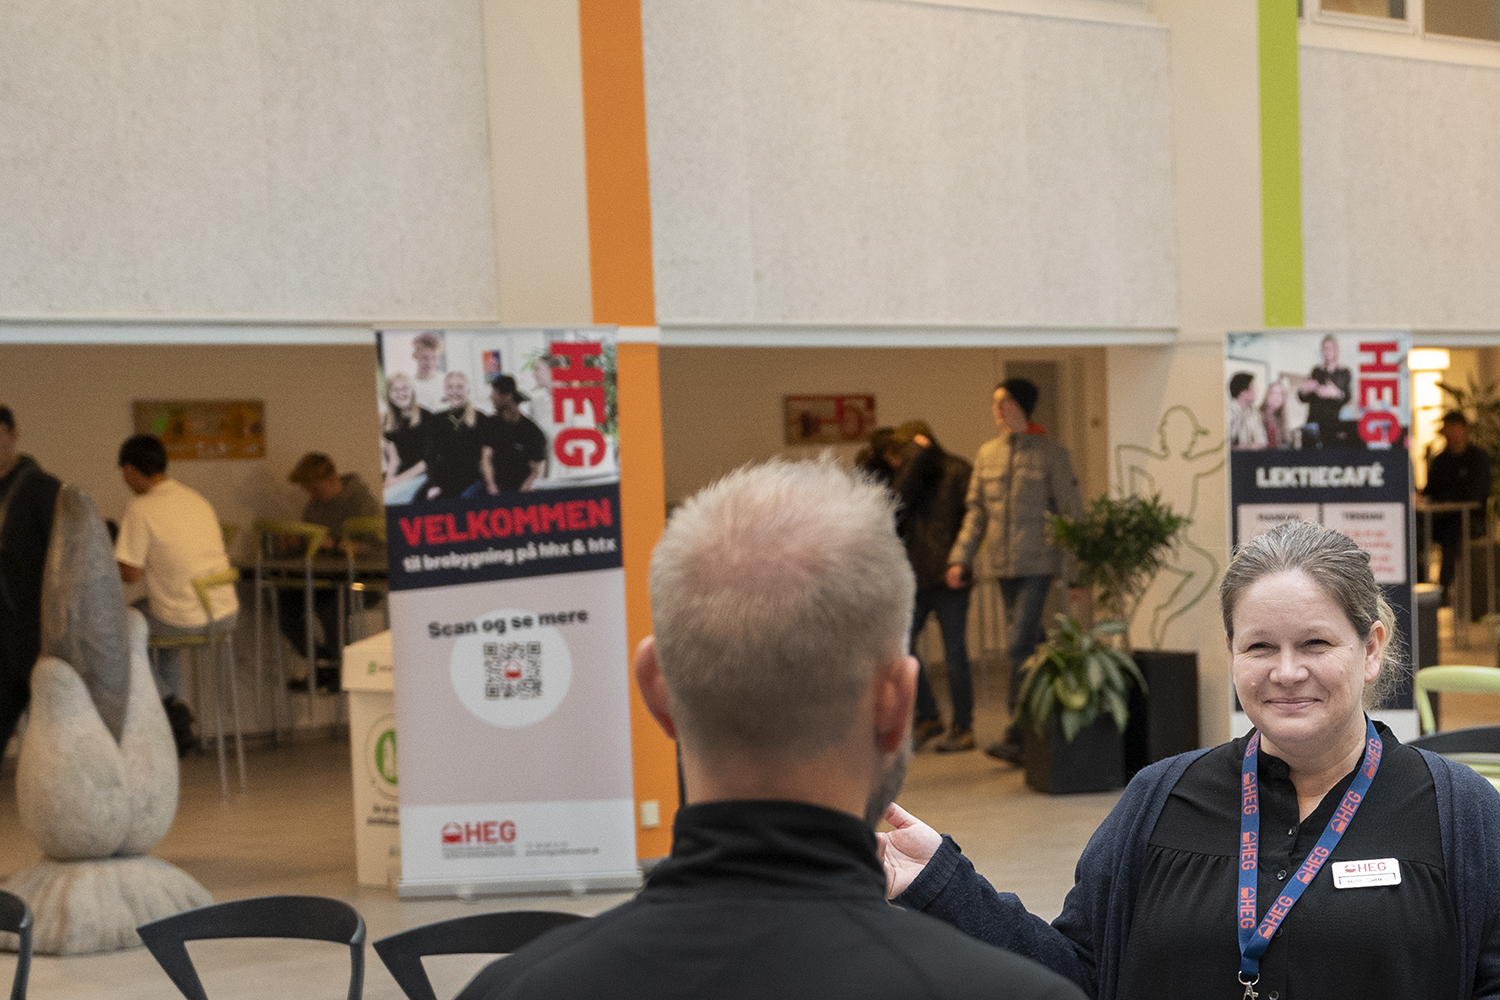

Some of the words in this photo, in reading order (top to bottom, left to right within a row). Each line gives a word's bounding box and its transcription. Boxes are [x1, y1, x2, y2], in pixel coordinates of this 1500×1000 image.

[550, 341, 607, 468] HEG
[1358, 343, 1401, 444] HEG
[1256, 462, 1385, 488] LEKTIECAFÉ
[399, 498, 613, 547] VELKOMMEN
[402, 554, 421, 572] til
[423, 547, 514, 570] brobygning
[516, 541, 537, 564] på
[572, 538, 585, 555] &
[428, 621, 477, 638] Scan
[482, 618, 506, 634] og
[511, 615, 533, 629] se
[538, 610, 588, 626] mere
[1366, 738, 1382, 766] HEG
[1243, 783, 1258, 815] HEG
[1336, 790, 1361, 825] HEG
[465, 820, 516, 844] HEG
[1241, 841, 1256, 871] HEG
[1303, 846, 1330, 876] HEG
[1357, 861, 1387, 872] HEG
[1240, 899, 1255, 929] HEG
[1265, 895, 1293, 928] HEG
